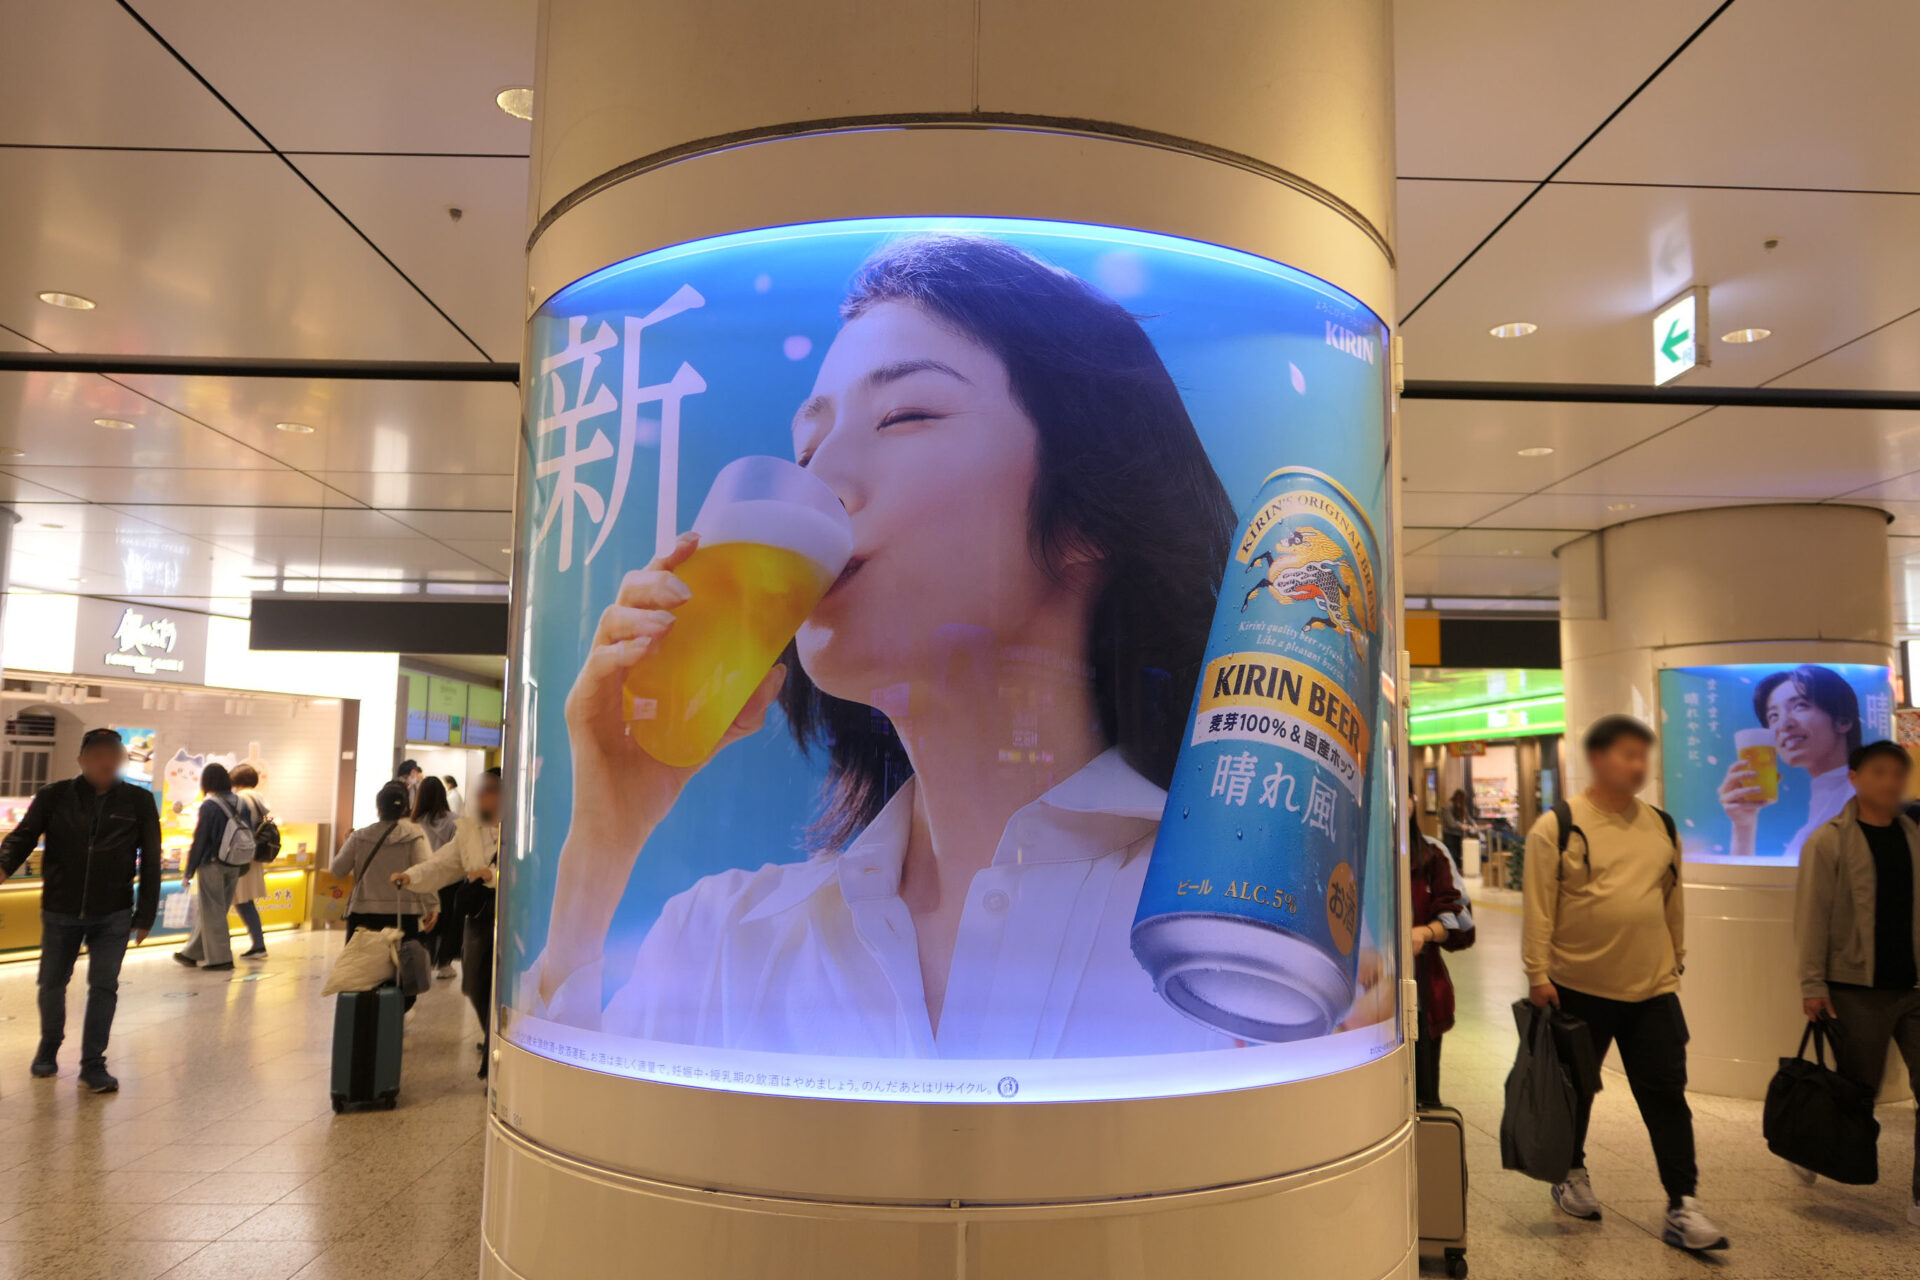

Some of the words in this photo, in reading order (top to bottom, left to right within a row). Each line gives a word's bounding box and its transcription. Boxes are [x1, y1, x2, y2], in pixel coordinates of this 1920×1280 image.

[1326, 320, 1374, 365] KIRIN
[532, 283, 707, 573] 新
[1242, 495, 1294, 553] KIRIN'S
[1298, 494, 1361, 555] ORIGINAL
[1239, 621, 1265, 632] Kirin's
[1267, 623, 1298, 639] quality
[1300, 630, 1317, 646] beer
[1256, 634, 1277, 645] Like
[1283, 640, 1321, 663] pleasant
[1213, 663, 1303, 706] KIRIN
[1308, 681, 1360, 752] BEER
[1210, 751, 1338, 844] 晴れ風
[1177, 879, 1214, 896] ビール
[1329, 881, 1356, 937] お酒
